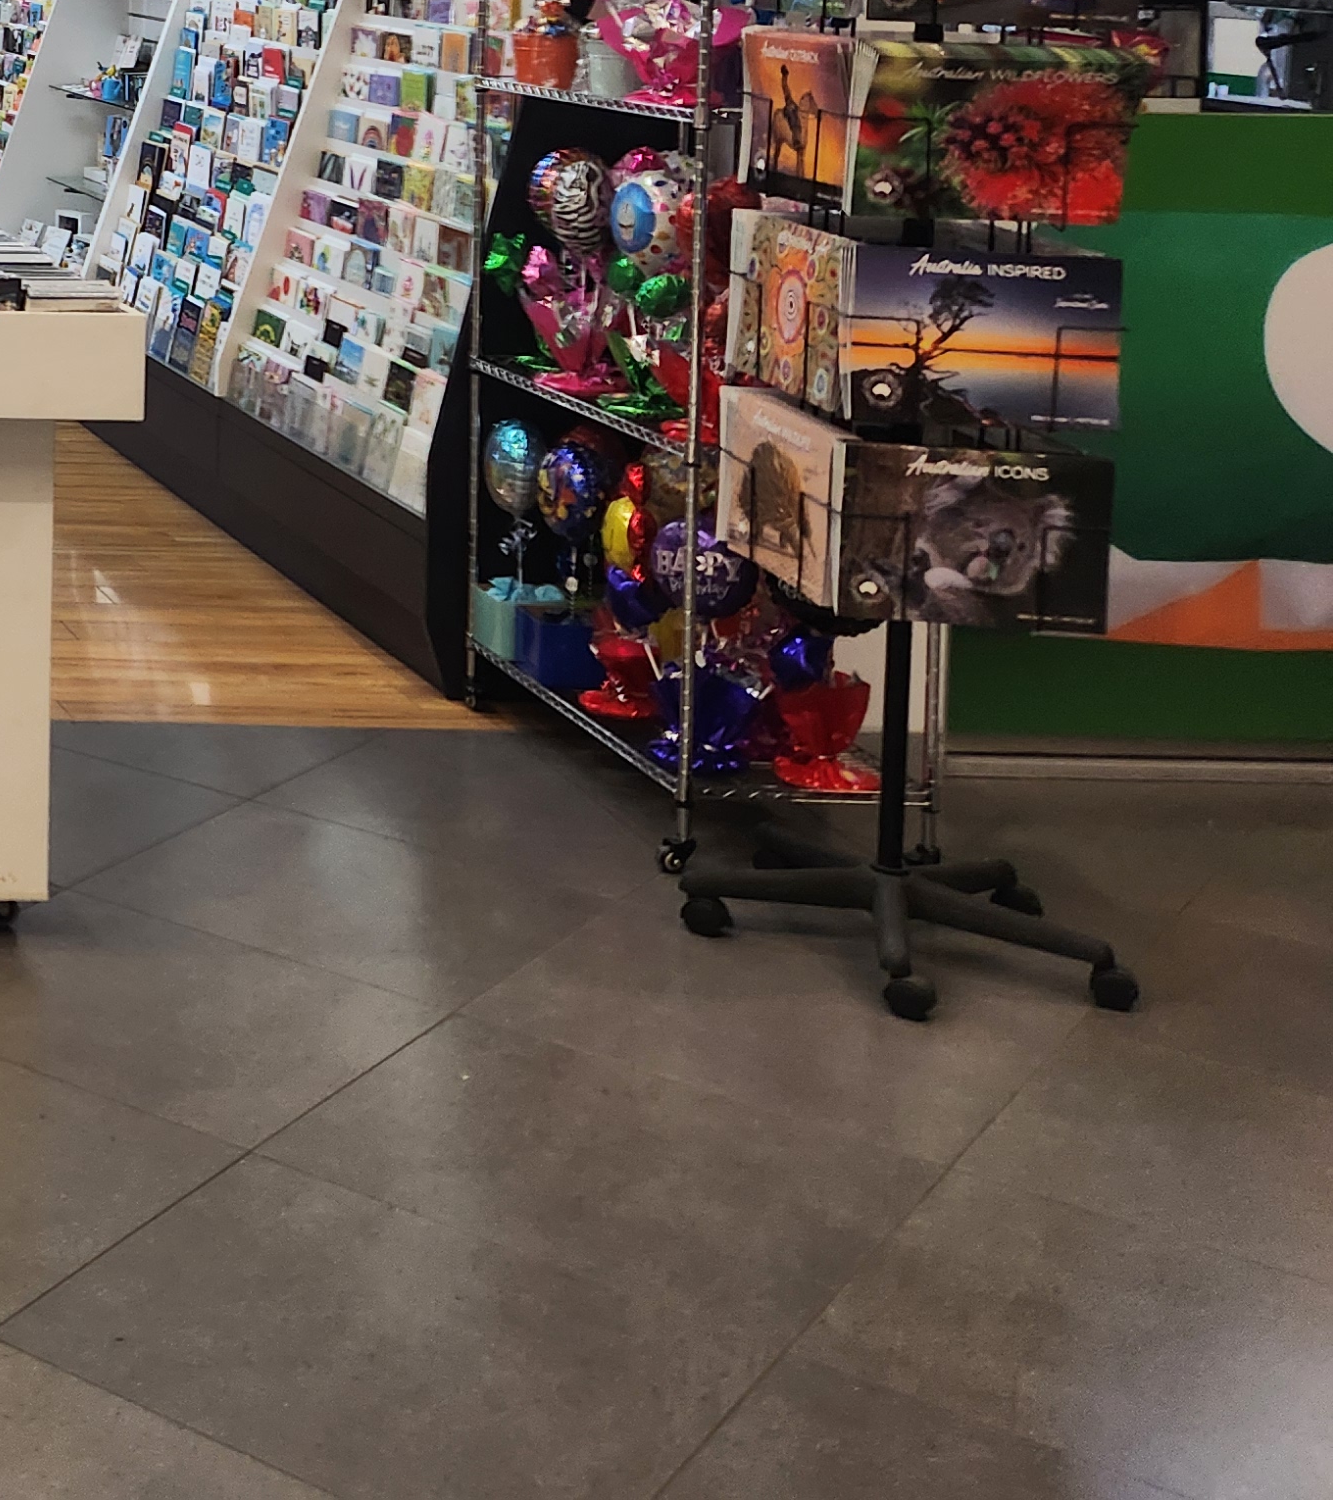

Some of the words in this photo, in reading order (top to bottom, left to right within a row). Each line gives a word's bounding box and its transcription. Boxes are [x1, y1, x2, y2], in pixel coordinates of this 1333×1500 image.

[895, 61, 985, 81] Australian
[989, 68, 1120, 86] WILDFLOWERS
[987, 263, 1067, 280] INSPIRED
[993, 466, 1050, 482] ICONS
